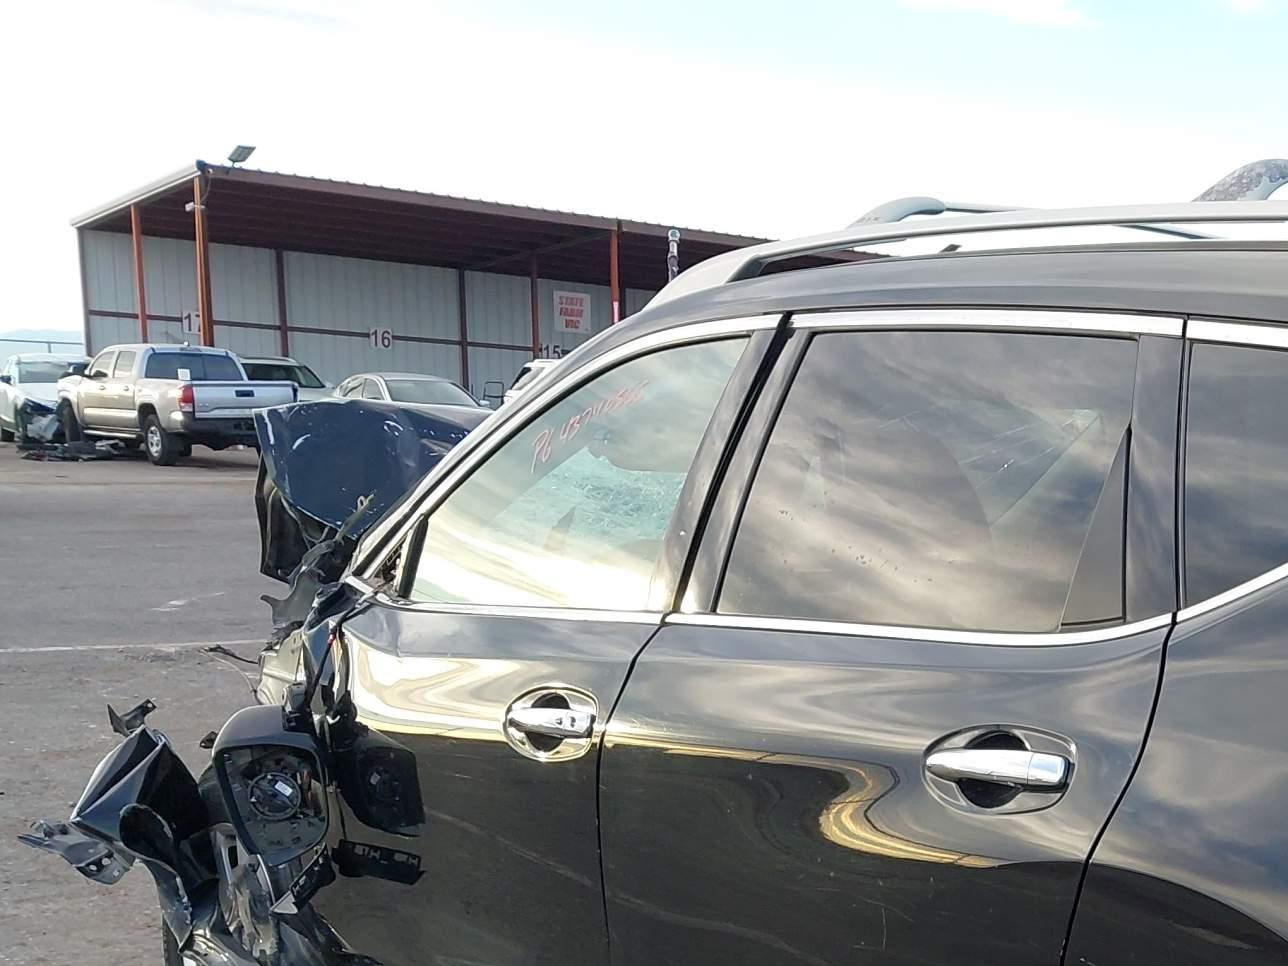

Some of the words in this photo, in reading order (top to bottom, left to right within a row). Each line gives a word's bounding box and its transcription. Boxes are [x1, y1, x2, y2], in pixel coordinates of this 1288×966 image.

[559, 296, 584, 307] STATE
[371, 329, 391, 349] 16
[543, 343, 561, 359] 15
